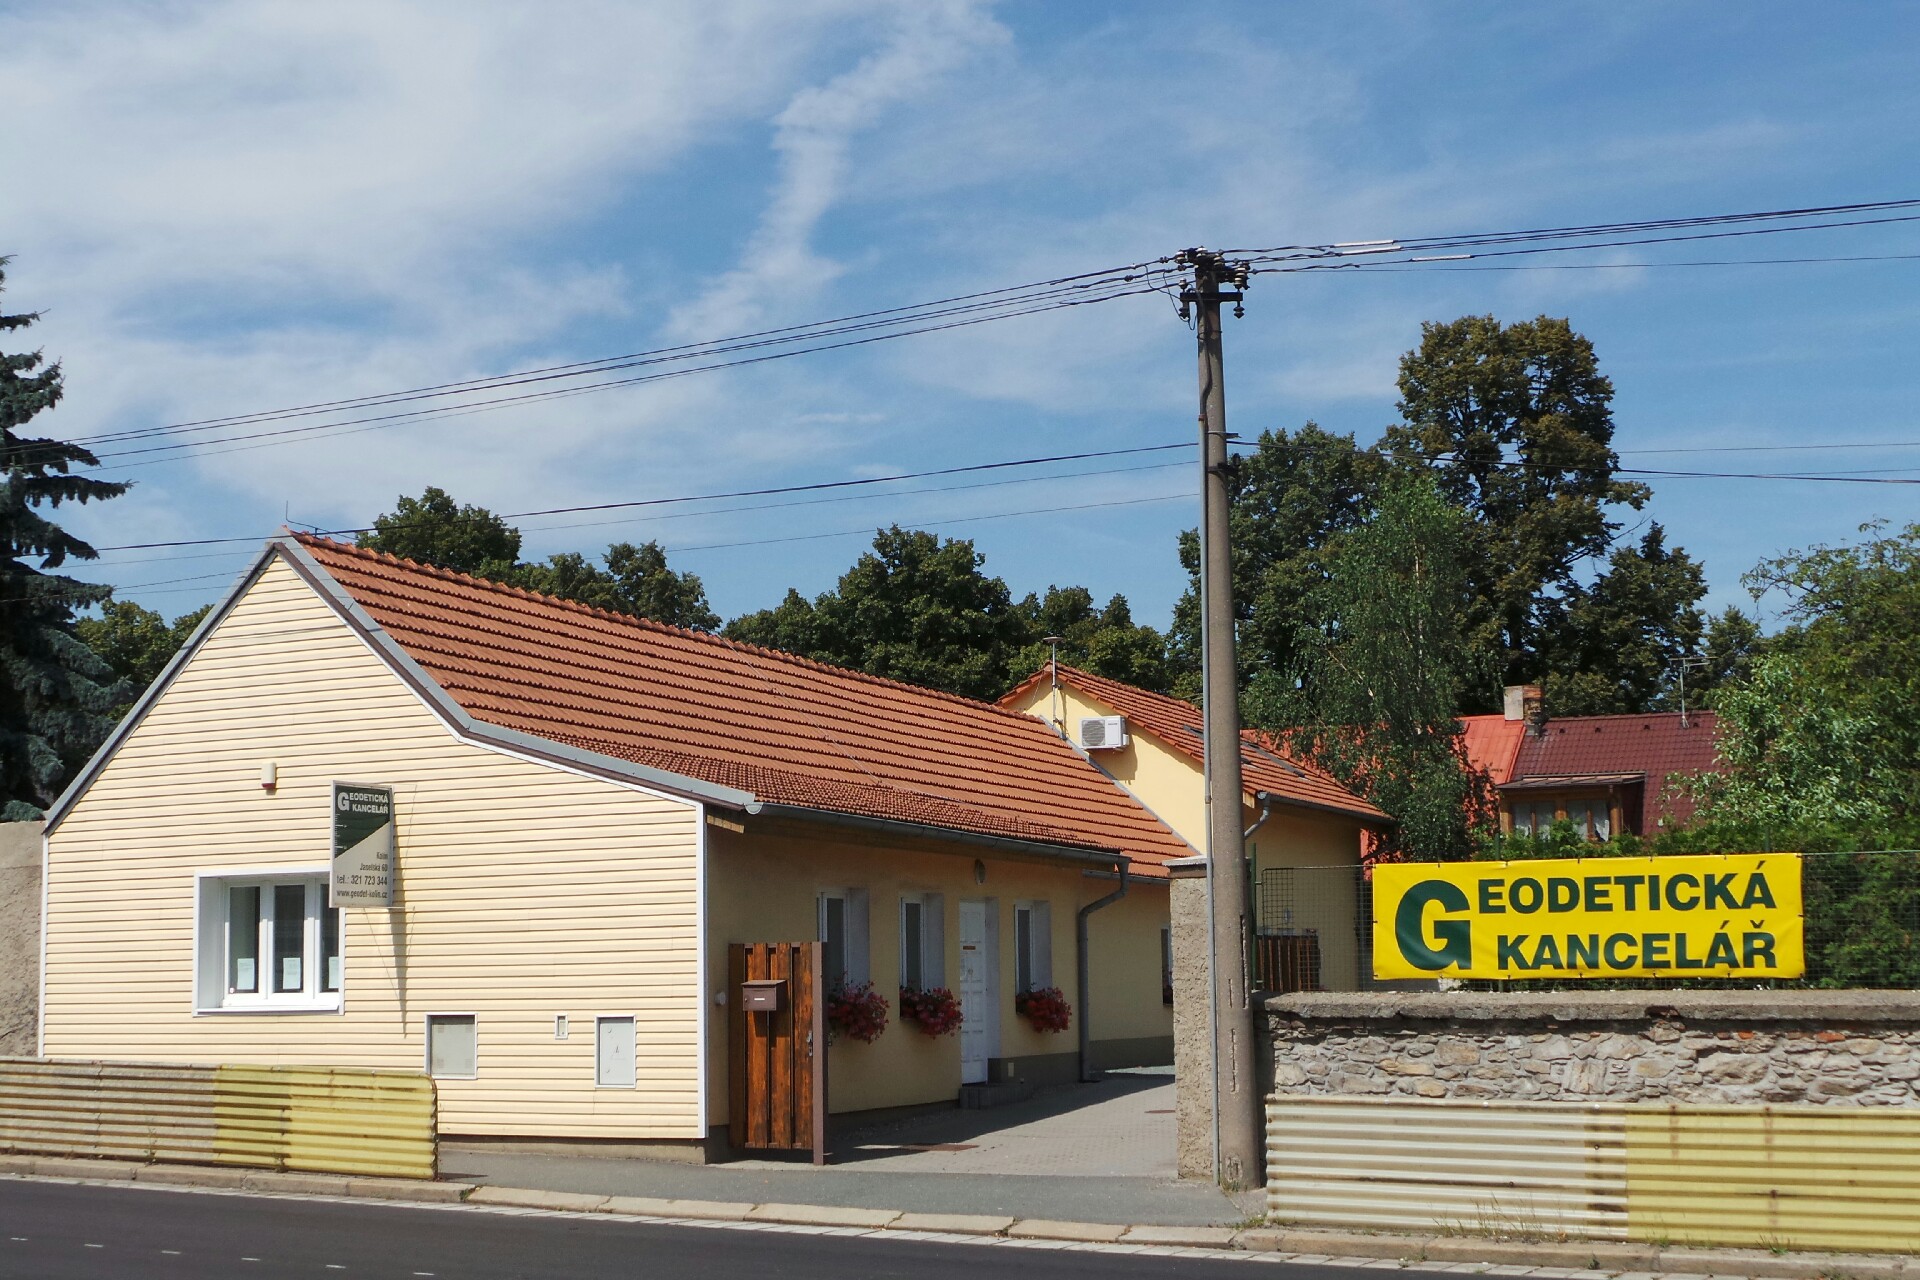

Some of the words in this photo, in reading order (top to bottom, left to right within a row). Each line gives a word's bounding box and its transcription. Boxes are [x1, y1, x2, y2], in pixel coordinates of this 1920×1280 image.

[338, 792, 389, 811] GEODETICKÁ
[352, 803, 389, 814] KANCELÁŘ
[350, 874, 362, 885] 321
[364, 876, 376, 886] 723
[376, 876, 388, 886] 344
[1395, 861, 1777, 971] GEODETICKÁ
[1497, 919, 1777, 971] KANCELÁŘ
